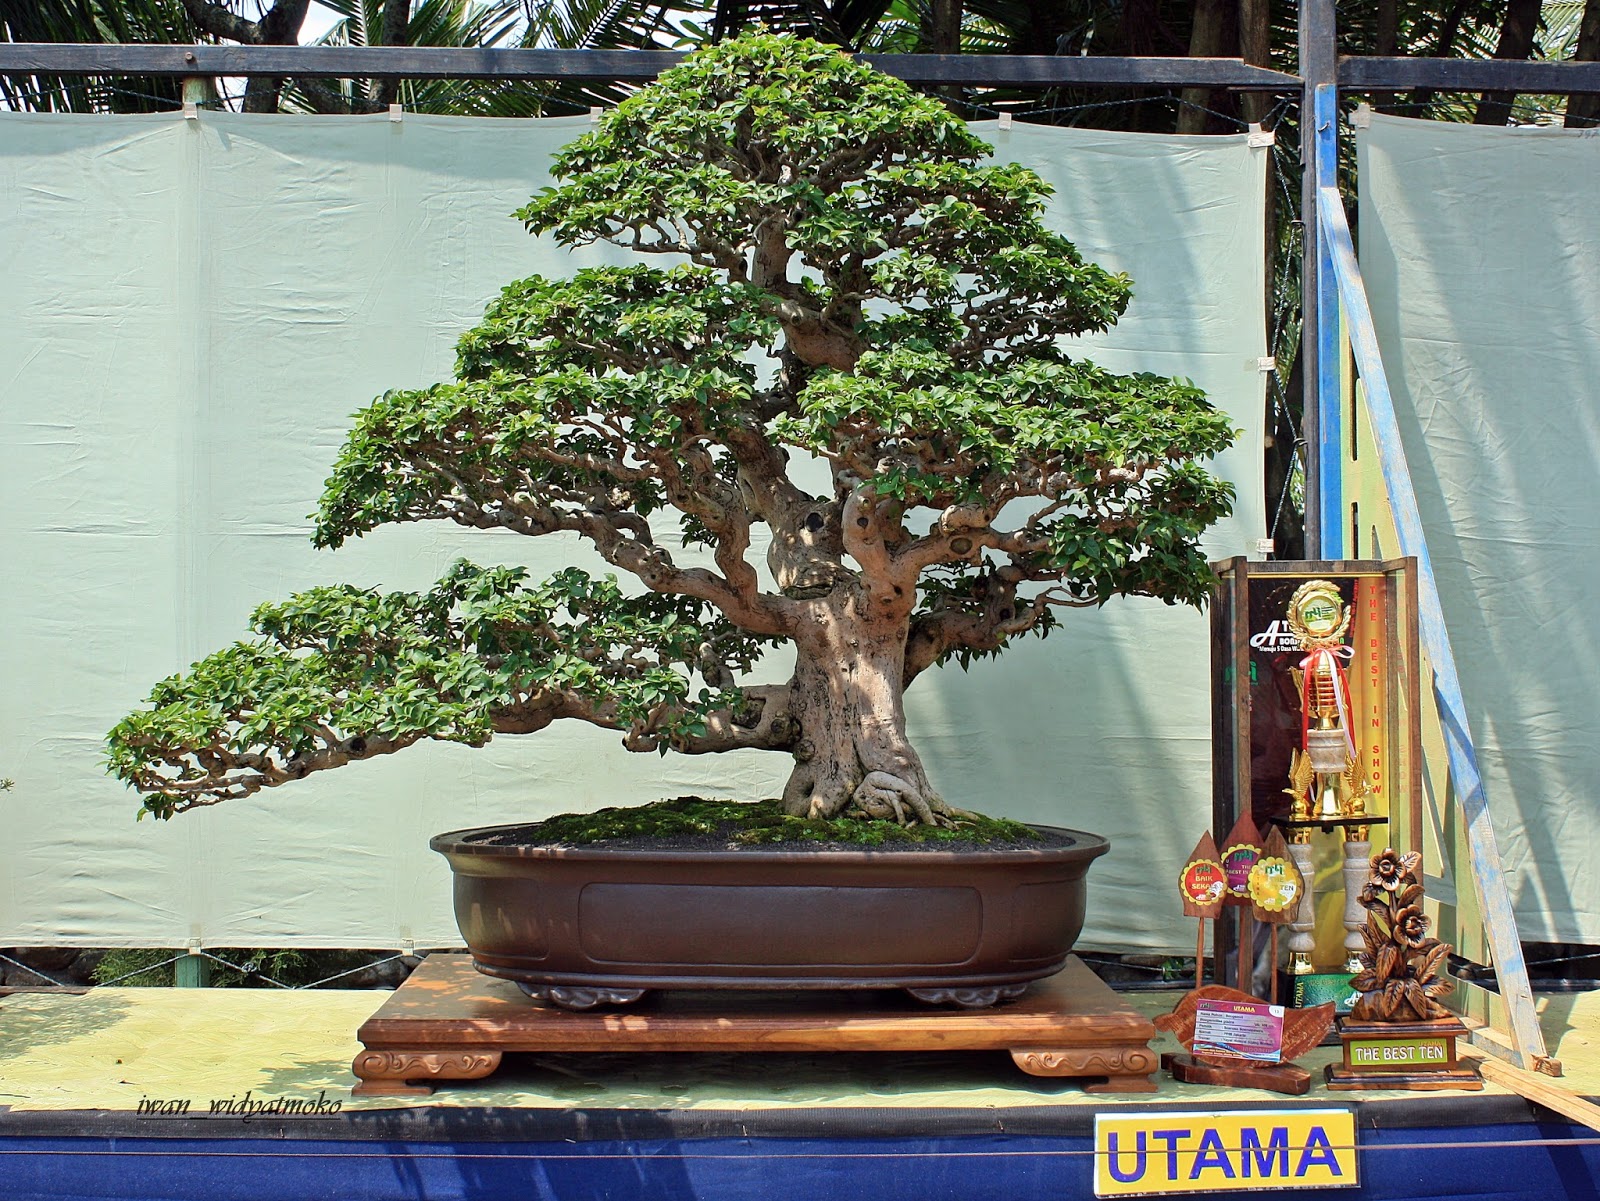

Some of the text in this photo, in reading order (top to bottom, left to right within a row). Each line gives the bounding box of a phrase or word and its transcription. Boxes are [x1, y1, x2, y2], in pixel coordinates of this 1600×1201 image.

[1369, 585, 1382, 794] THE BEST IN SHOW
[1233, 1005, 1256, 1013] UTAMA
[1355, 1046, 1443, 1061] THE BEST TEN
[1107, 1126, 1343, 1183] UTAMA
